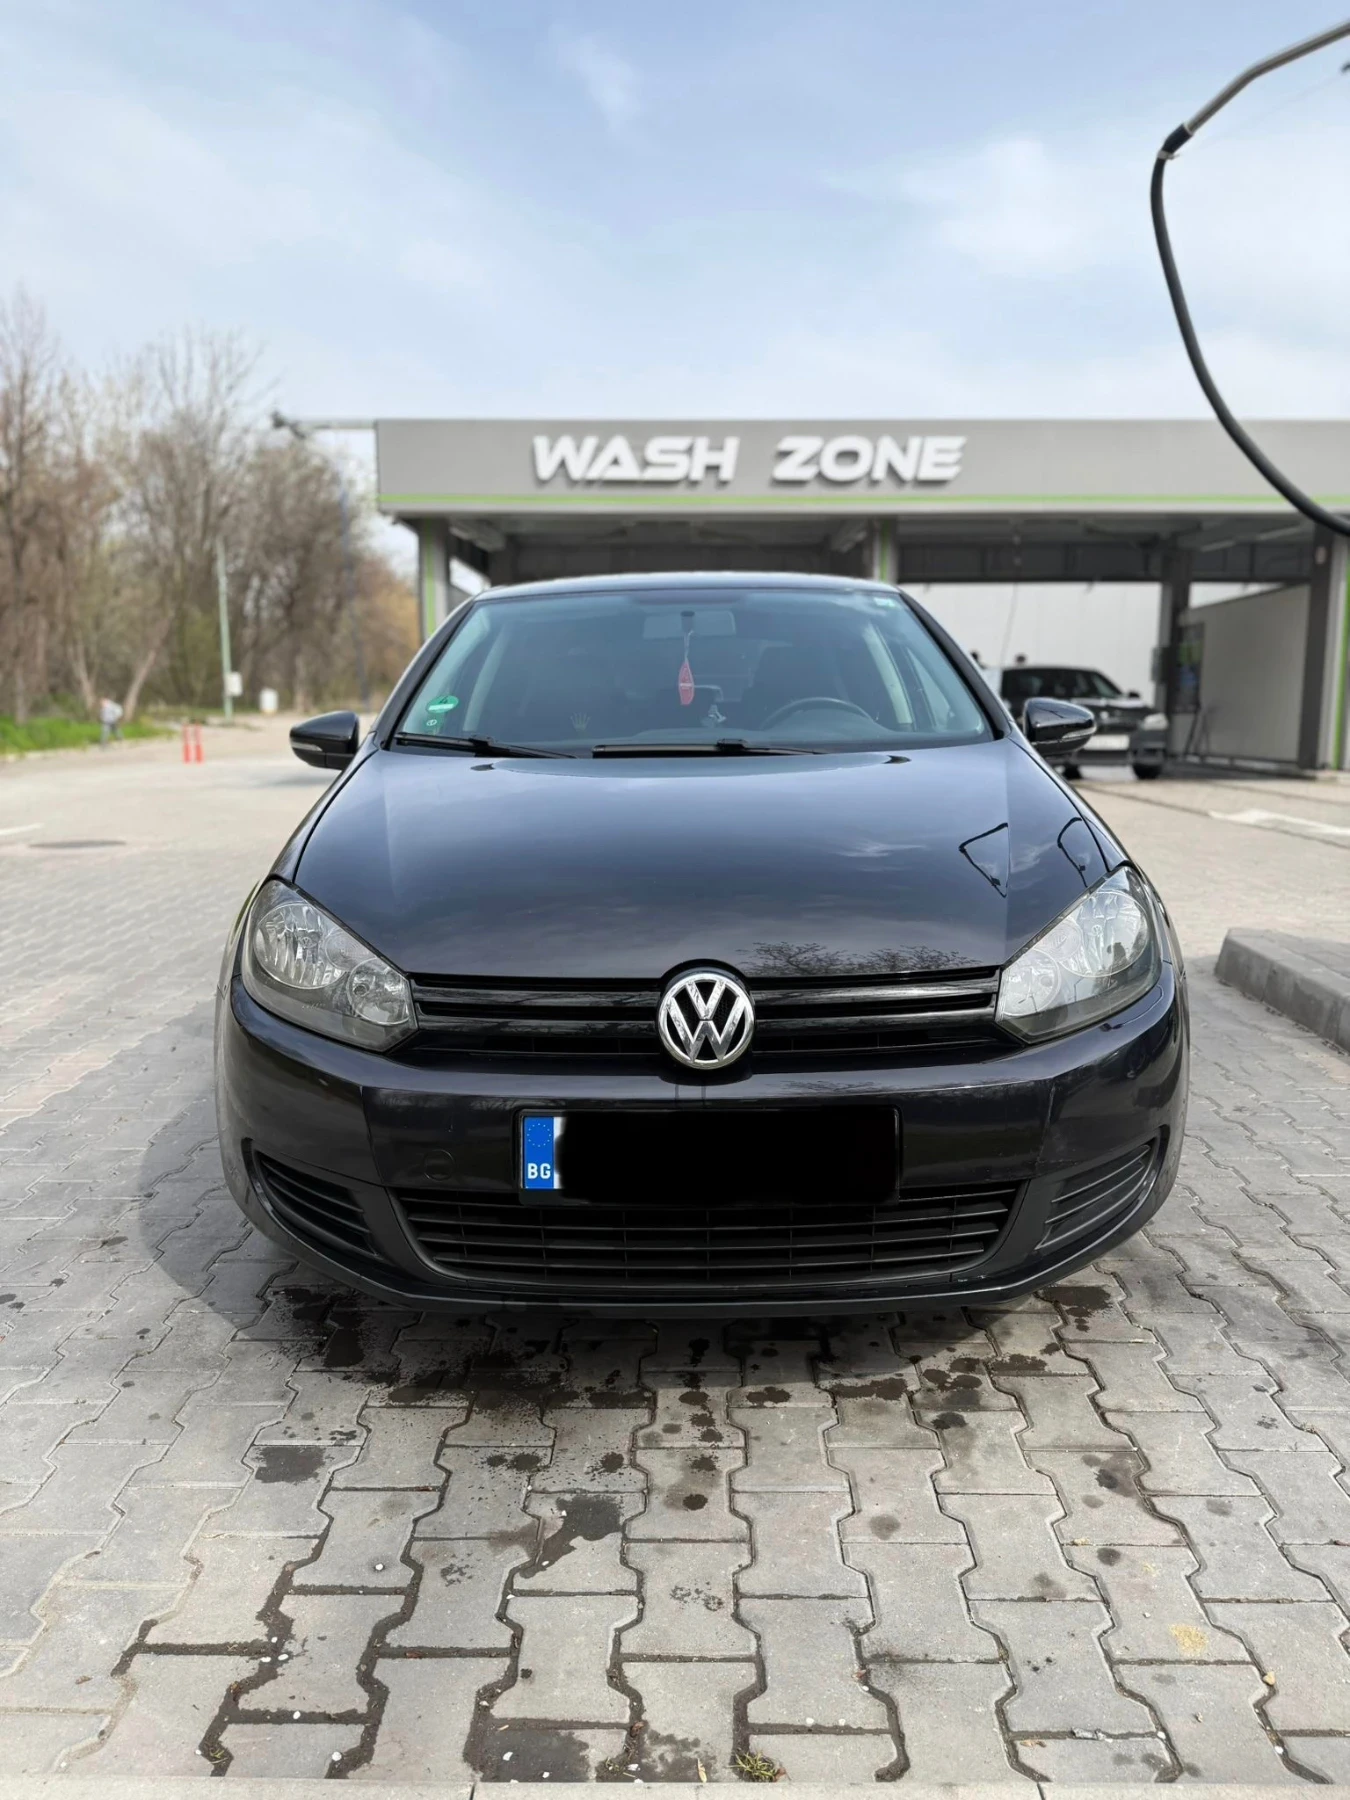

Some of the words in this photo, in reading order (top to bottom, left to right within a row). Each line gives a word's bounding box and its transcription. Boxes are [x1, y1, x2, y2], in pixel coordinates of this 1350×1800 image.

[532, 435, 741, 483] WASH
[772, 435, 967, 483] ZONE
[662, 976, 751, 1065] VW
[527, 1162, 551, 1179] BG
